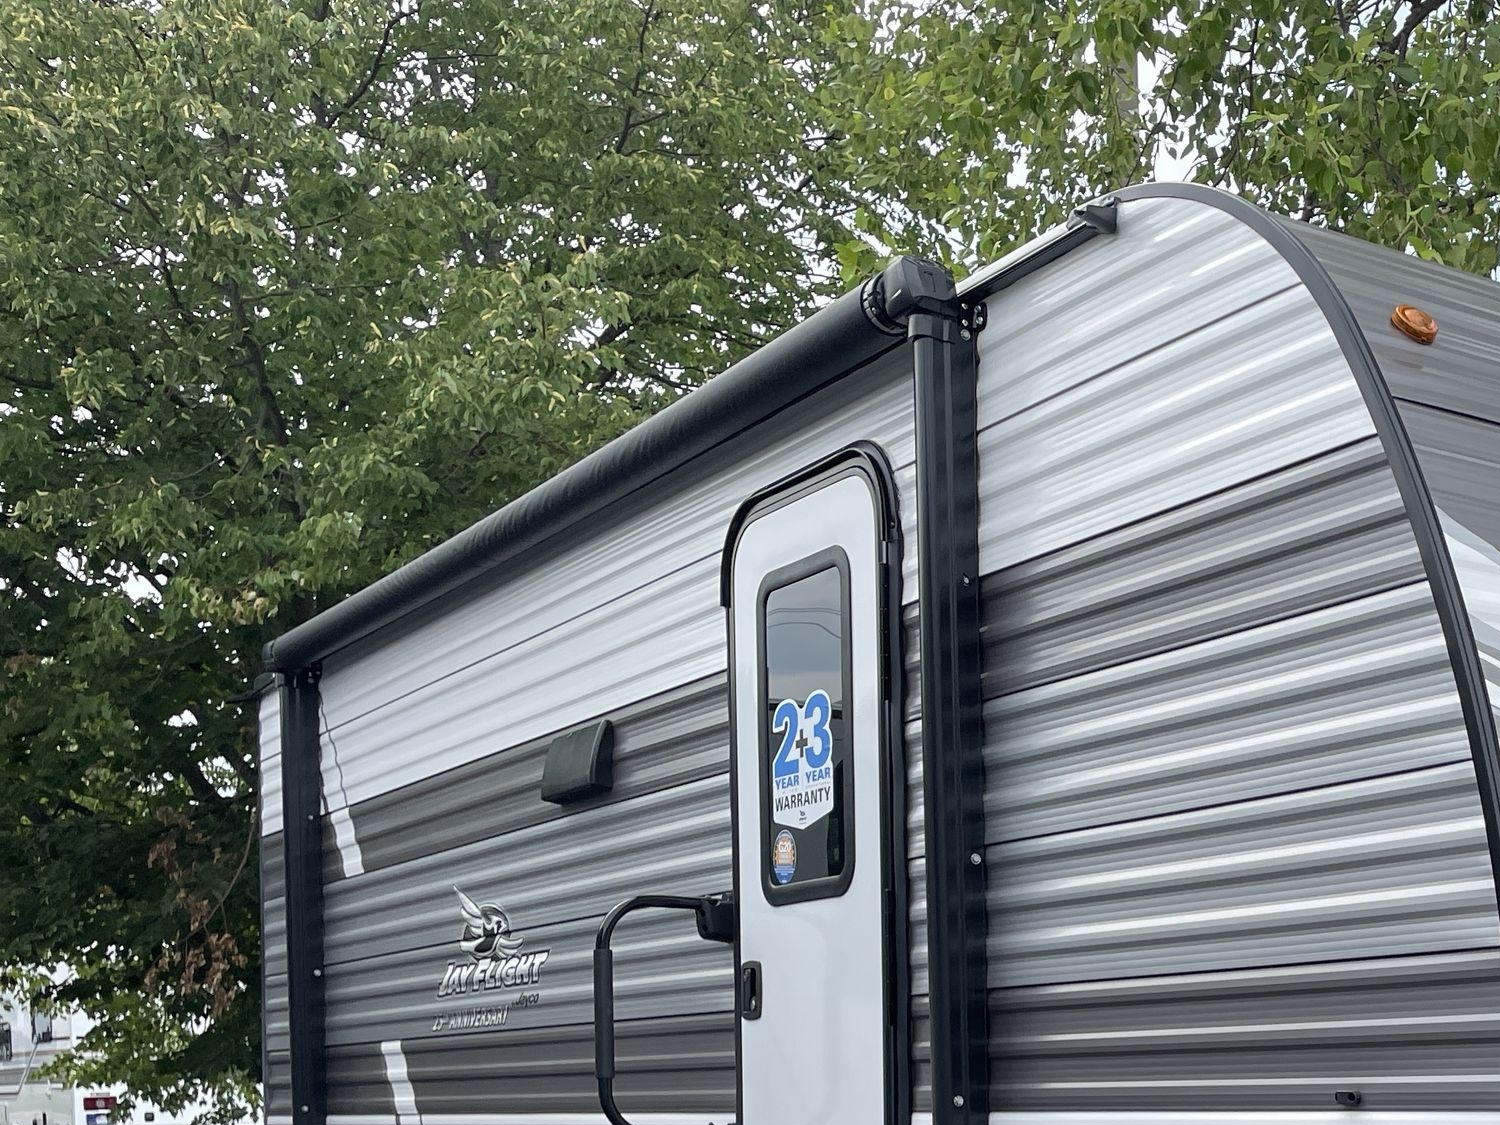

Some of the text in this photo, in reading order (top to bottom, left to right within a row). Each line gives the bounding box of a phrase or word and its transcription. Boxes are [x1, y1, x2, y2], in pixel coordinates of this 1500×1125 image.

[775, 774, 800, 790] YEAR
[805, 767, 831, 783] YEAR
[775, 786, 831, 812] WARRANTY
[437, 949, 550, 997] JAY FLIGHT
